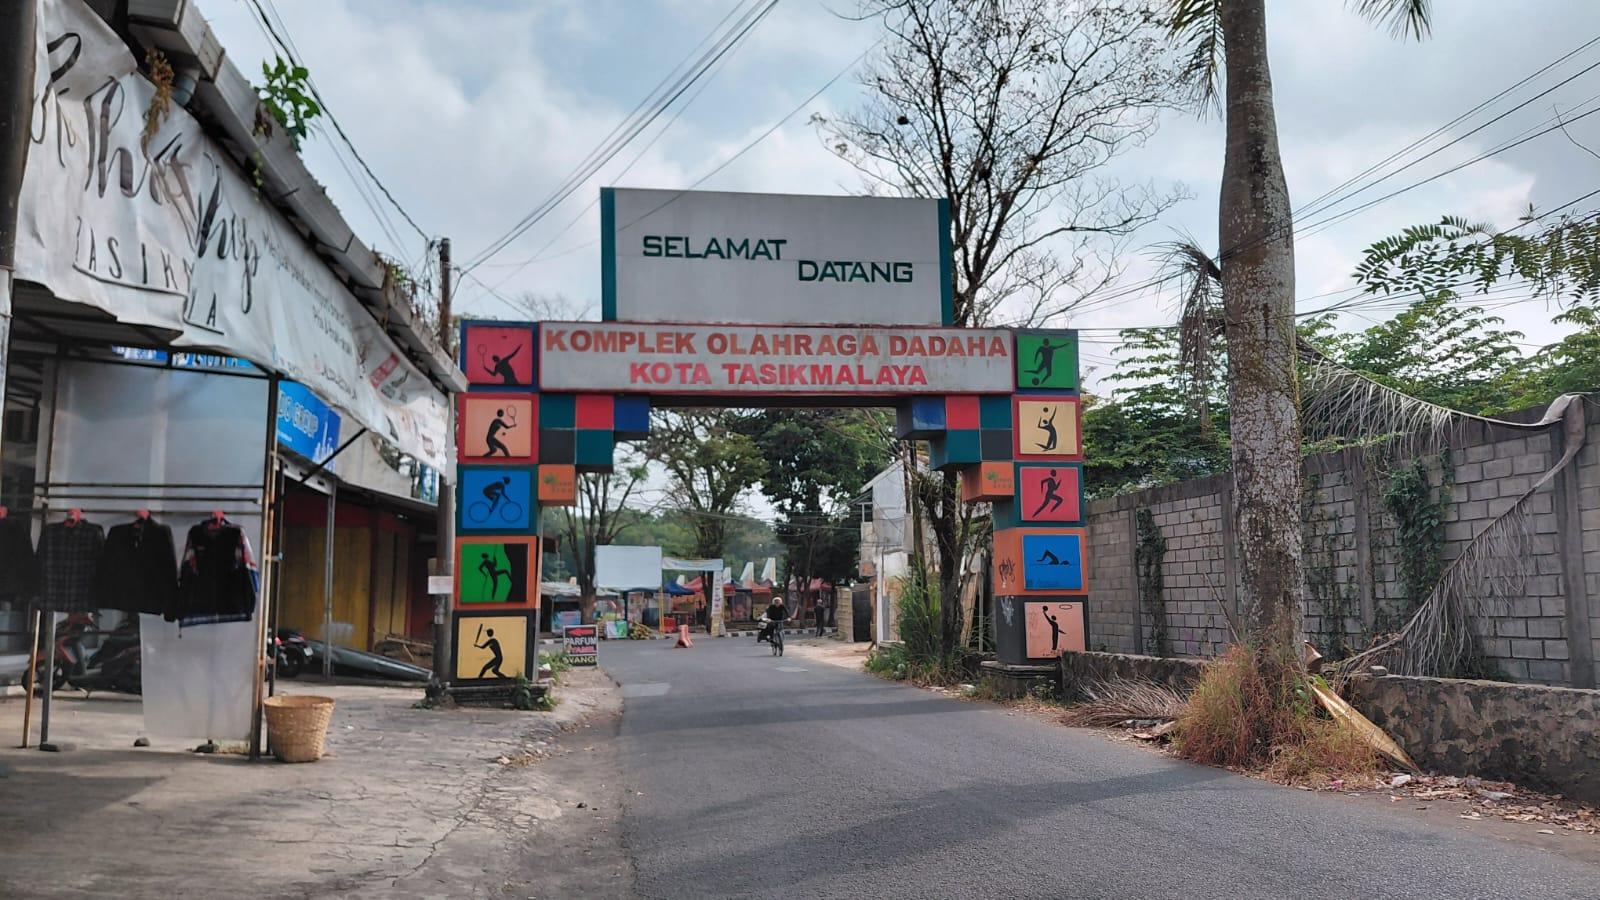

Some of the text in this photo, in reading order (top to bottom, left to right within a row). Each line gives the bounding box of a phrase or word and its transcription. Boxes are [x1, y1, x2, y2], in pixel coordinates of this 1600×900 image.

[642, 235, 788, 261] SELAMAT
[797, 259, 914, 284] DATANG
[545, 329, 1008, 358] KOMPLEK OLAHRAGA DADAHA
[629, 361, 929, 386] KOTA TASIKMALAYA
[564, 637, 597, 645] PARFUM
